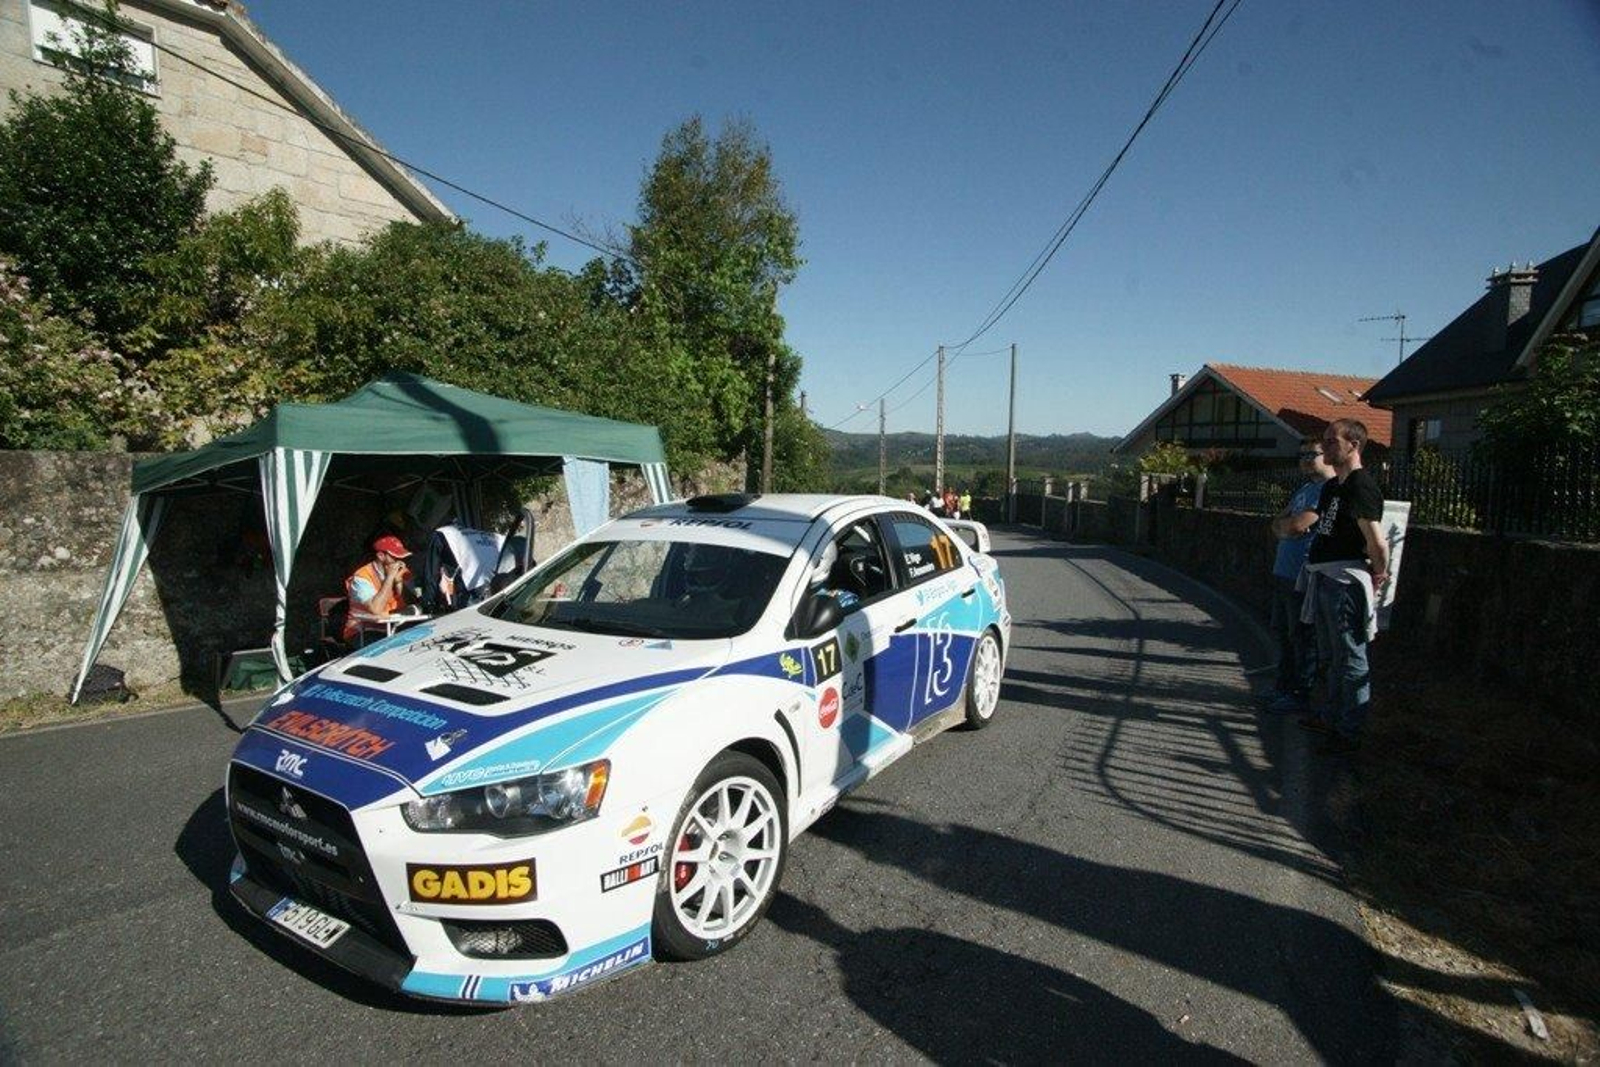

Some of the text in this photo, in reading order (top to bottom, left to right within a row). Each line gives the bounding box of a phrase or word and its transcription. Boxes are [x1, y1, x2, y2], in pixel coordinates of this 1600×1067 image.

[931, 534, 955, 570] 17
[817, 643, 836, 676] 17
[619, 841, 664, 865] REPSOL
[413, 866, 532, 899] GADIS
[550, 942, 644, 993] MICHELIN
